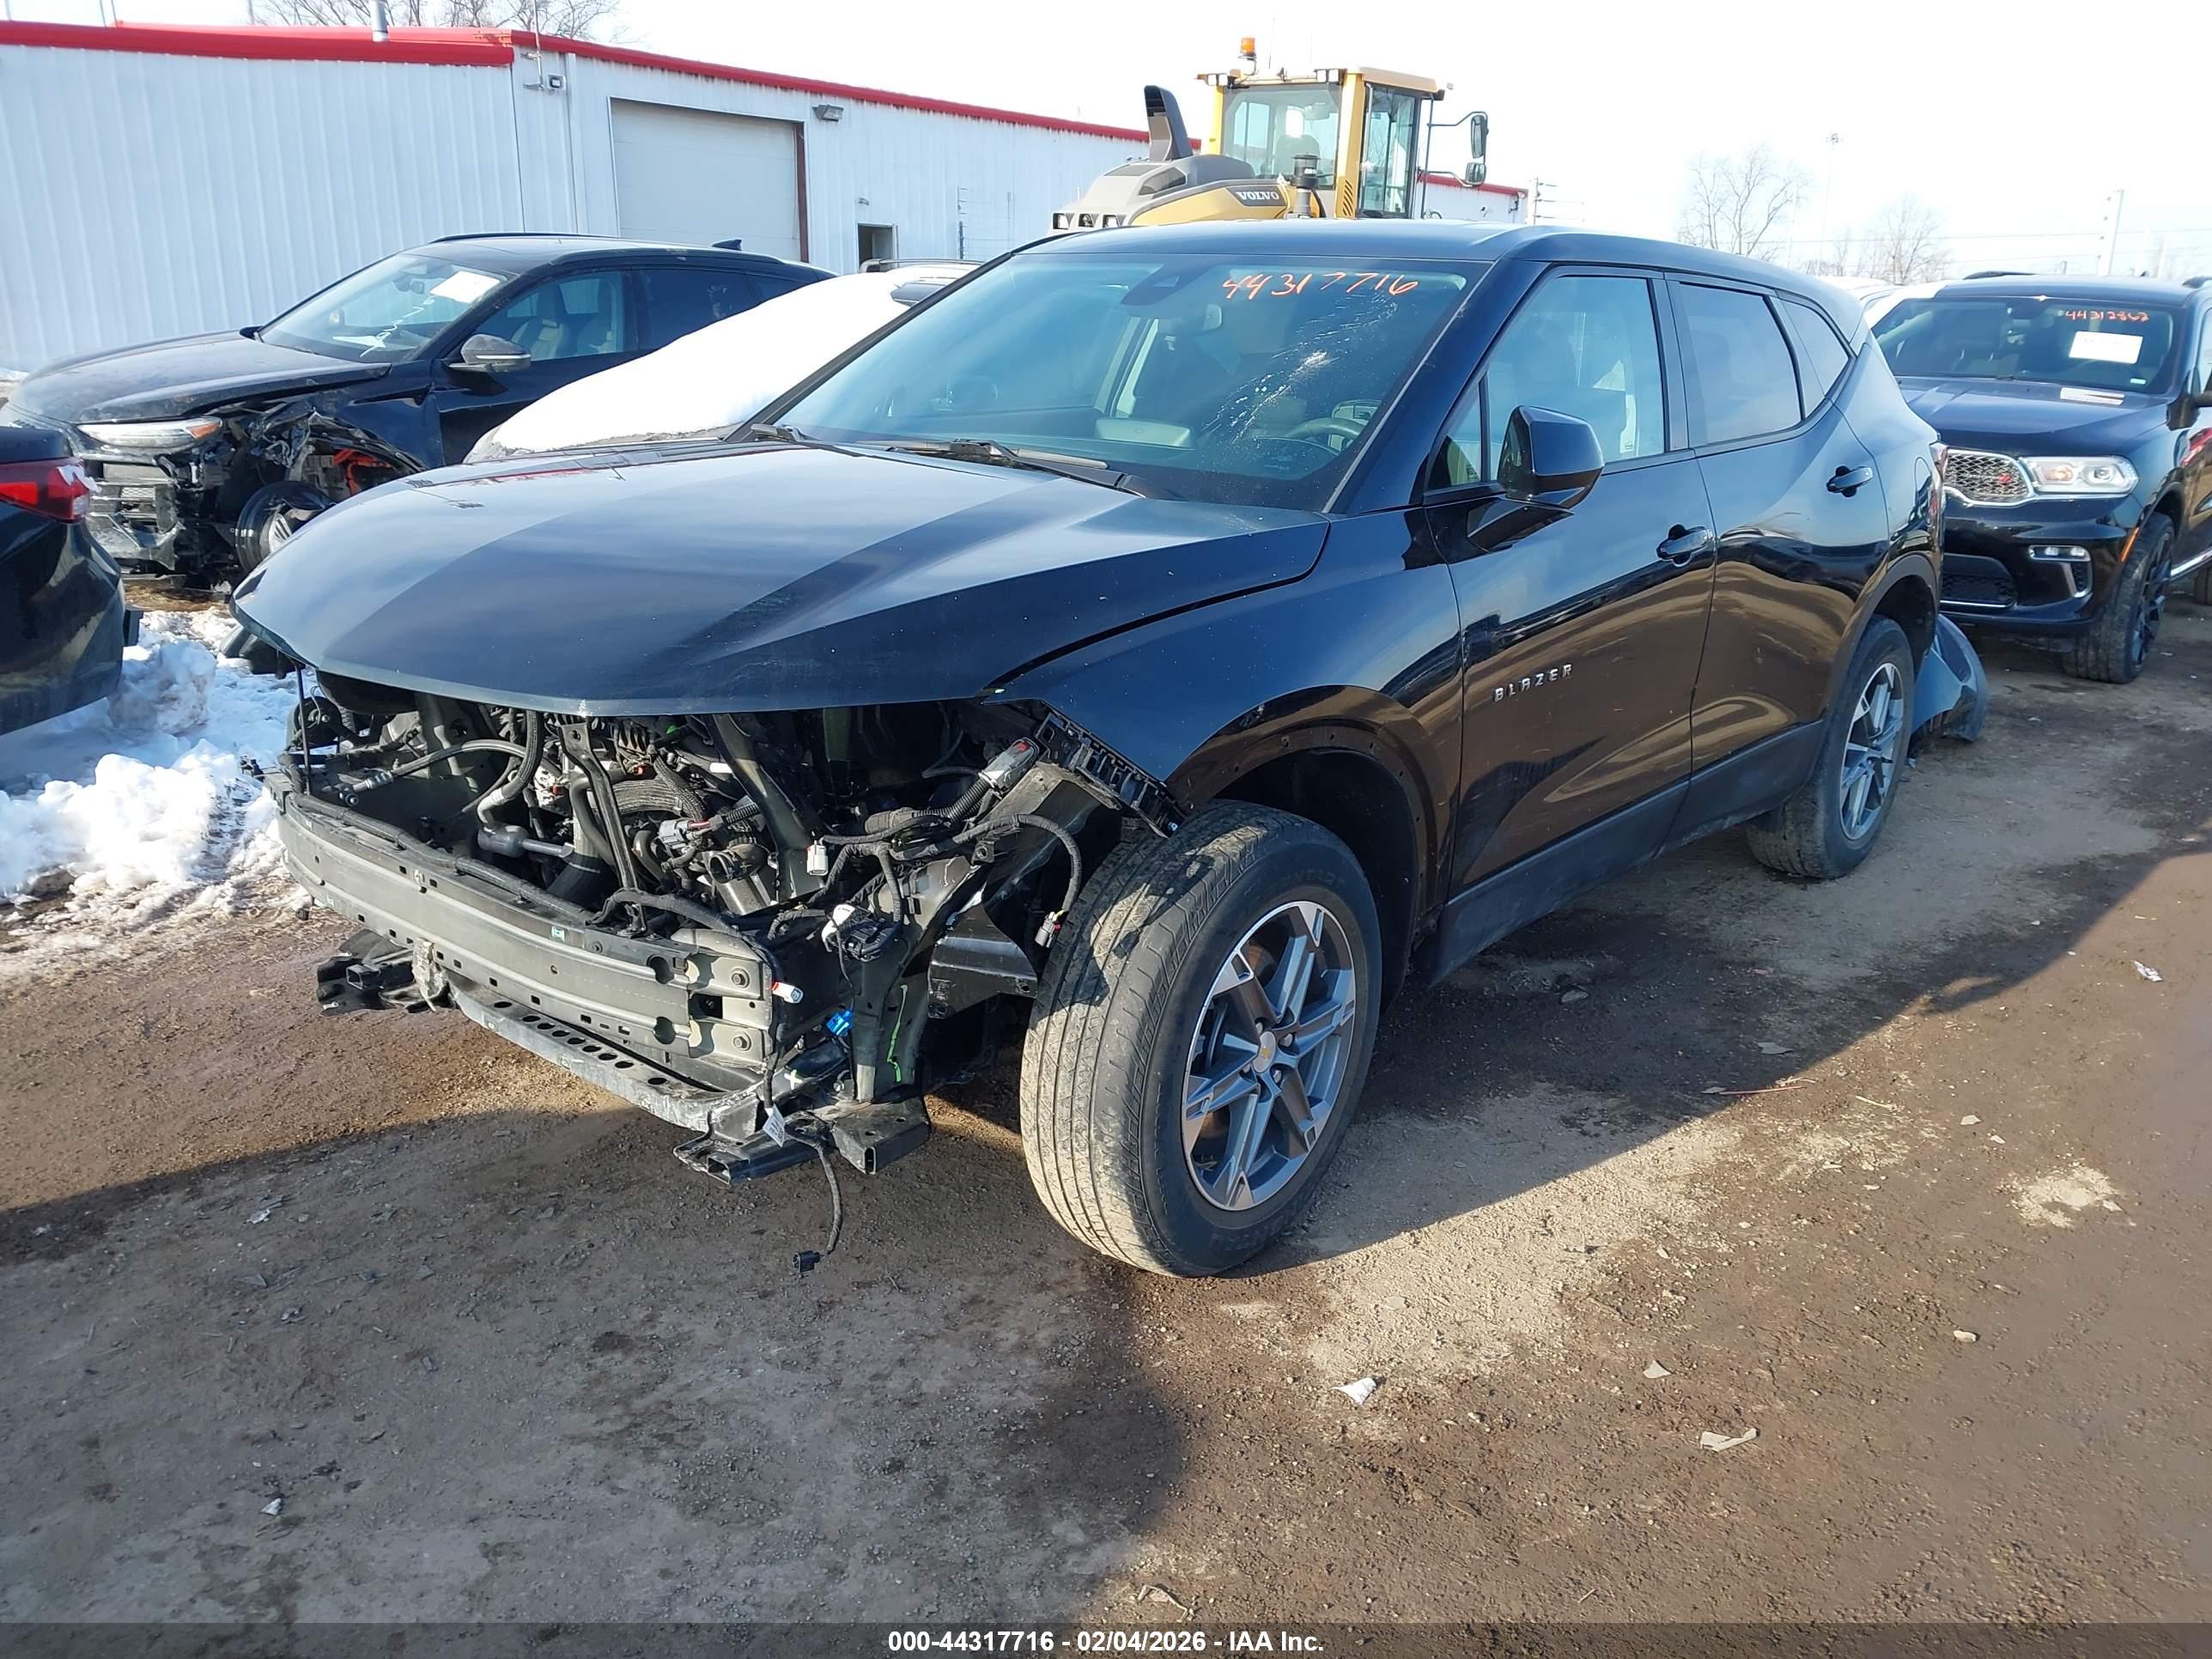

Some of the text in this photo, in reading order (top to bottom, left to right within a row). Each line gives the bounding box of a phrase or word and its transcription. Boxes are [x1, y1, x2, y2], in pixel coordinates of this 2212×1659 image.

[1235, 191, 1279, 200] VOLVO
[1221, 270, 1419, 301] 44317716
[2064, 309, 2150, 322] 44312862
[1493, 664, 1572, 702] BLAZER
